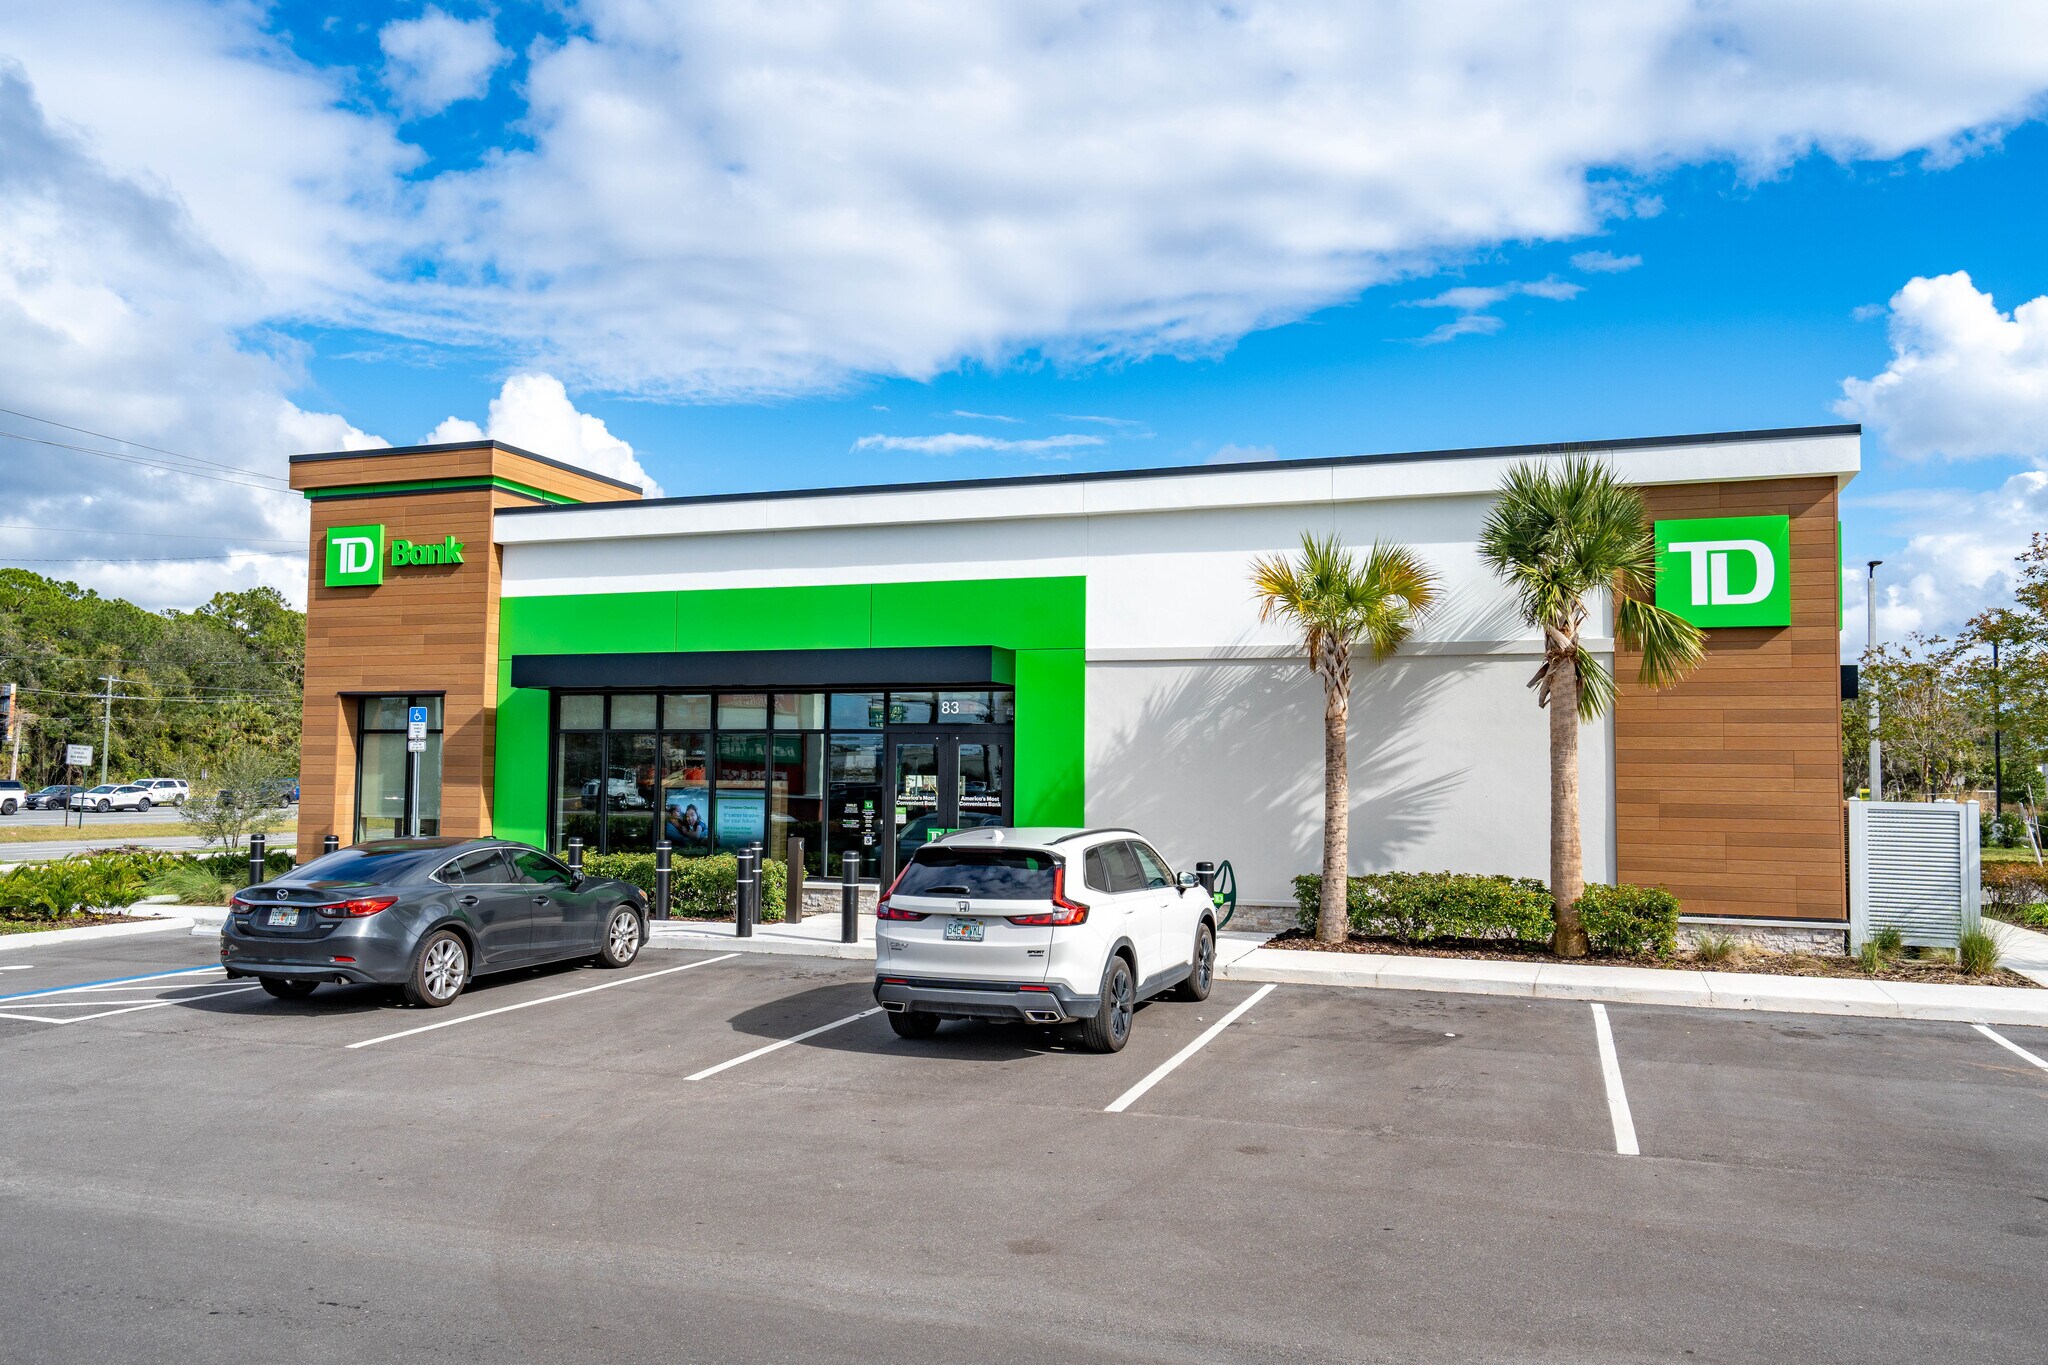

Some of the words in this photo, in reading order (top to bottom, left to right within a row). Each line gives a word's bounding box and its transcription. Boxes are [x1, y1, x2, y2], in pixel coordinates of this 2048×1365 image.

[331, 536, 375, 574] TD
[391, 535, 465, 566] Bank
[1668, 539, 1775, 606] TD
[941, 701, 960, 714] 83
